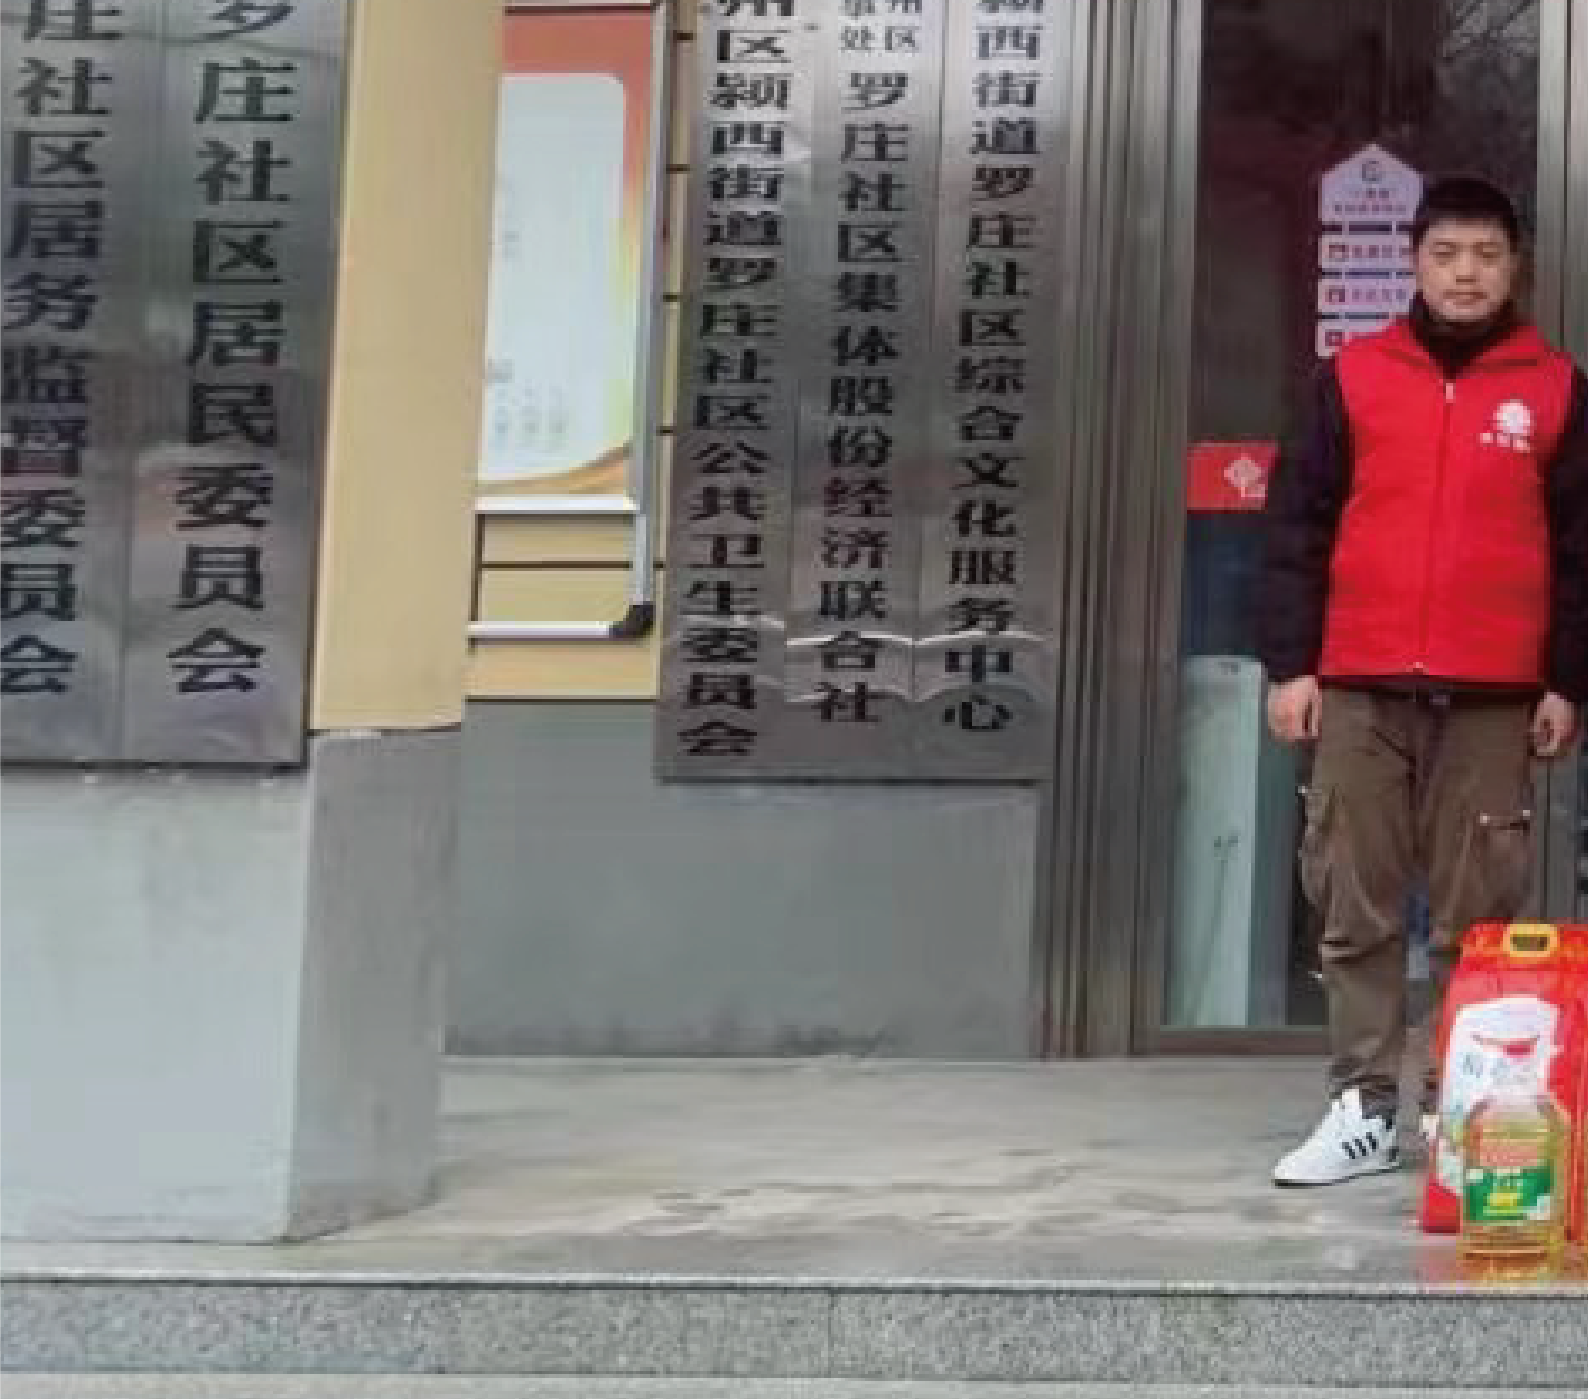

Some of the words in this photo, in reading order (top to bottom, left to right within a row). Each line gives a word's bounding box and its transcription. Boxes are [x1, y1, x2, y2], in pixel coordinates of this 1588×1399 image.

[813, 72, 909, 725] 罗庄社区集体股份经济联合社
